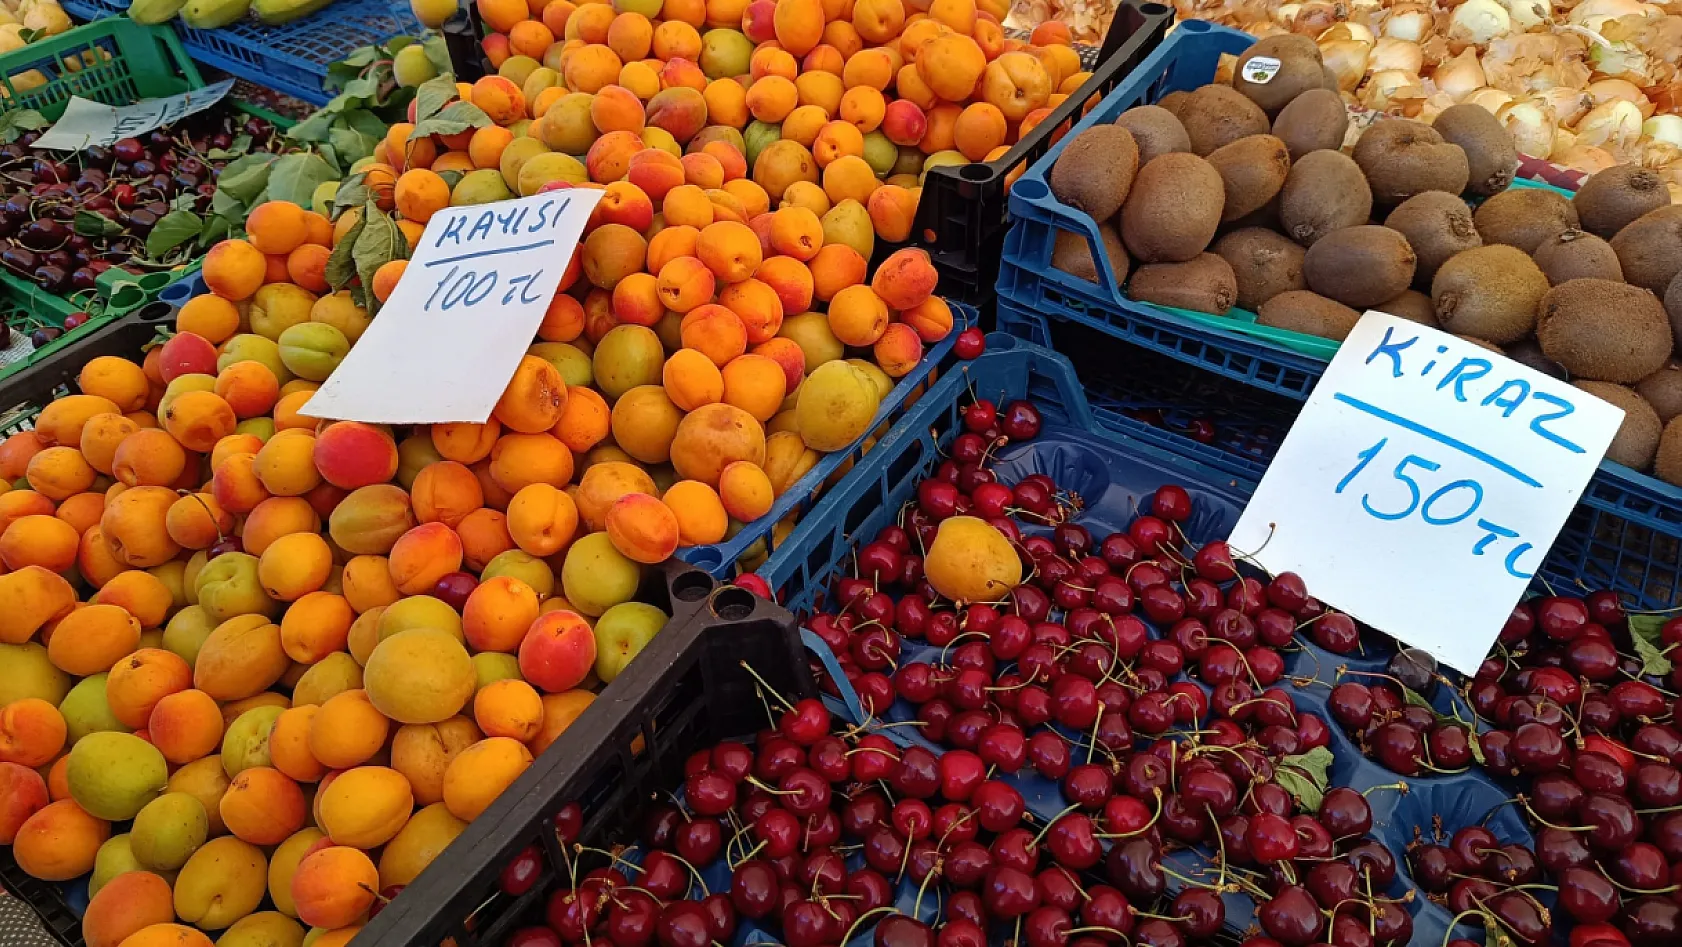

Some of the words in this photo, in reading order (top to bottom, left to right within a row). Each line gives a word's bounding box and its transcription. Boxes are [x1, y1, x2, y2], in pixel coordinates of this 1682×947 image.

[435, 198, 571, 248] KAYISI
[424, 265, 498, 311] 100
[502, 269, 544, 305] TL
[1335, 437, 1484, 526] 150
[1472, 518, 1534, 578] TL
